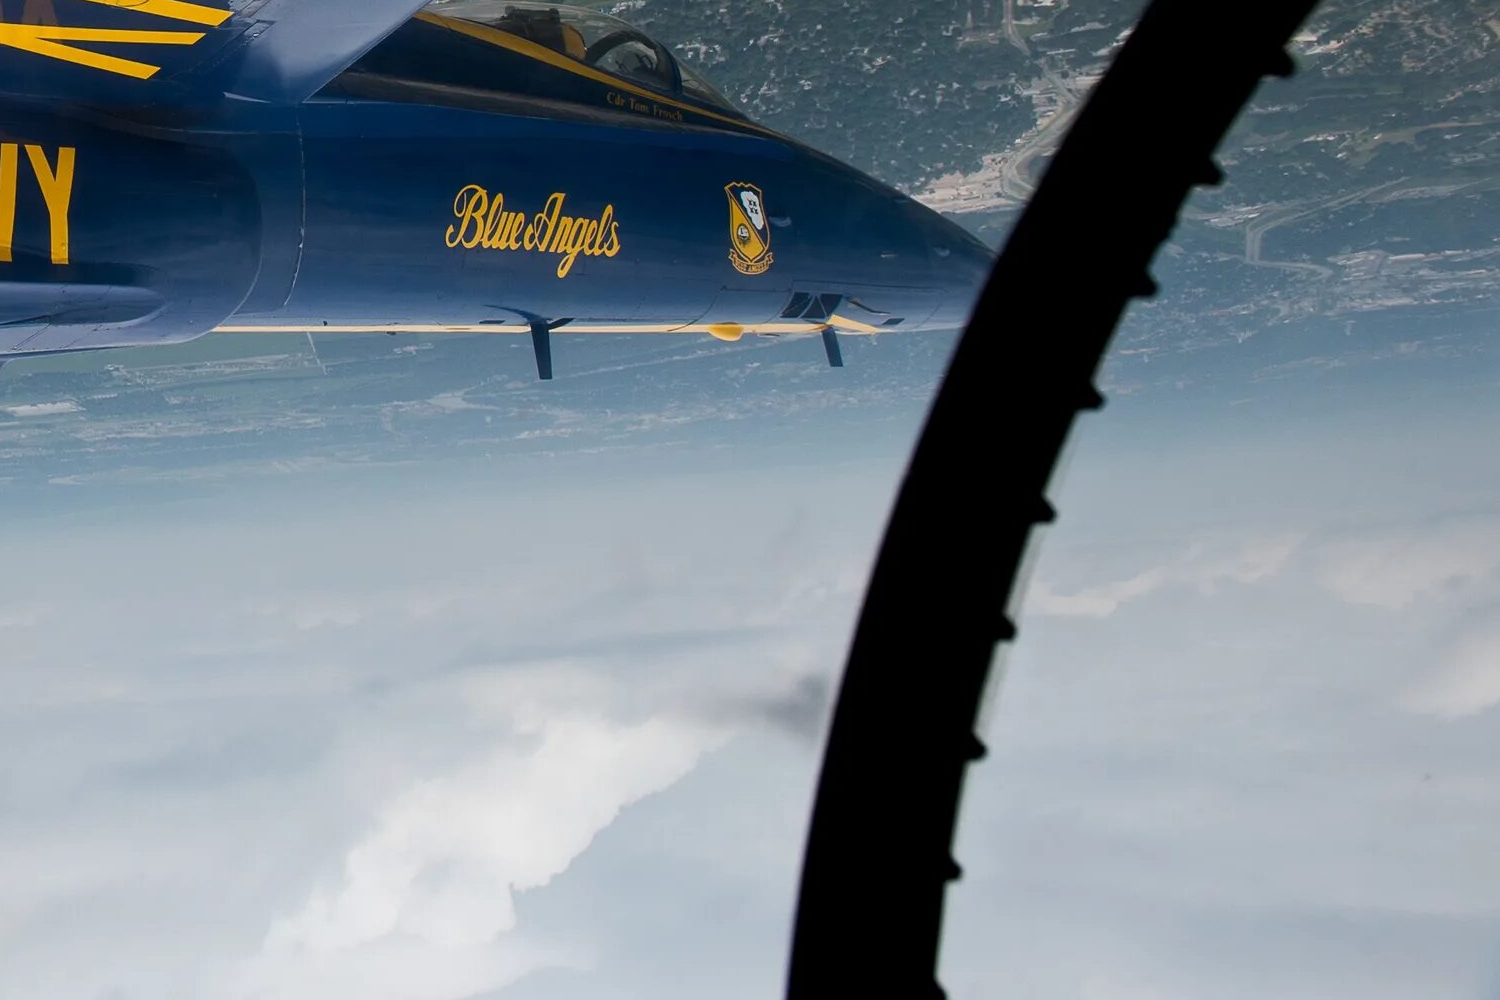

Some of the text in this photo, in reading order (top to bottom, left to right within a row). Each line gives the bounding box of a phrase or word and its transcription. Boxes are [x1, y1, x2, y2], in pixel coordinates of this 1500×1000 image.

[606, 91, 625, 107] Cdr
[445, 184, 621, 279] Blue Angels
